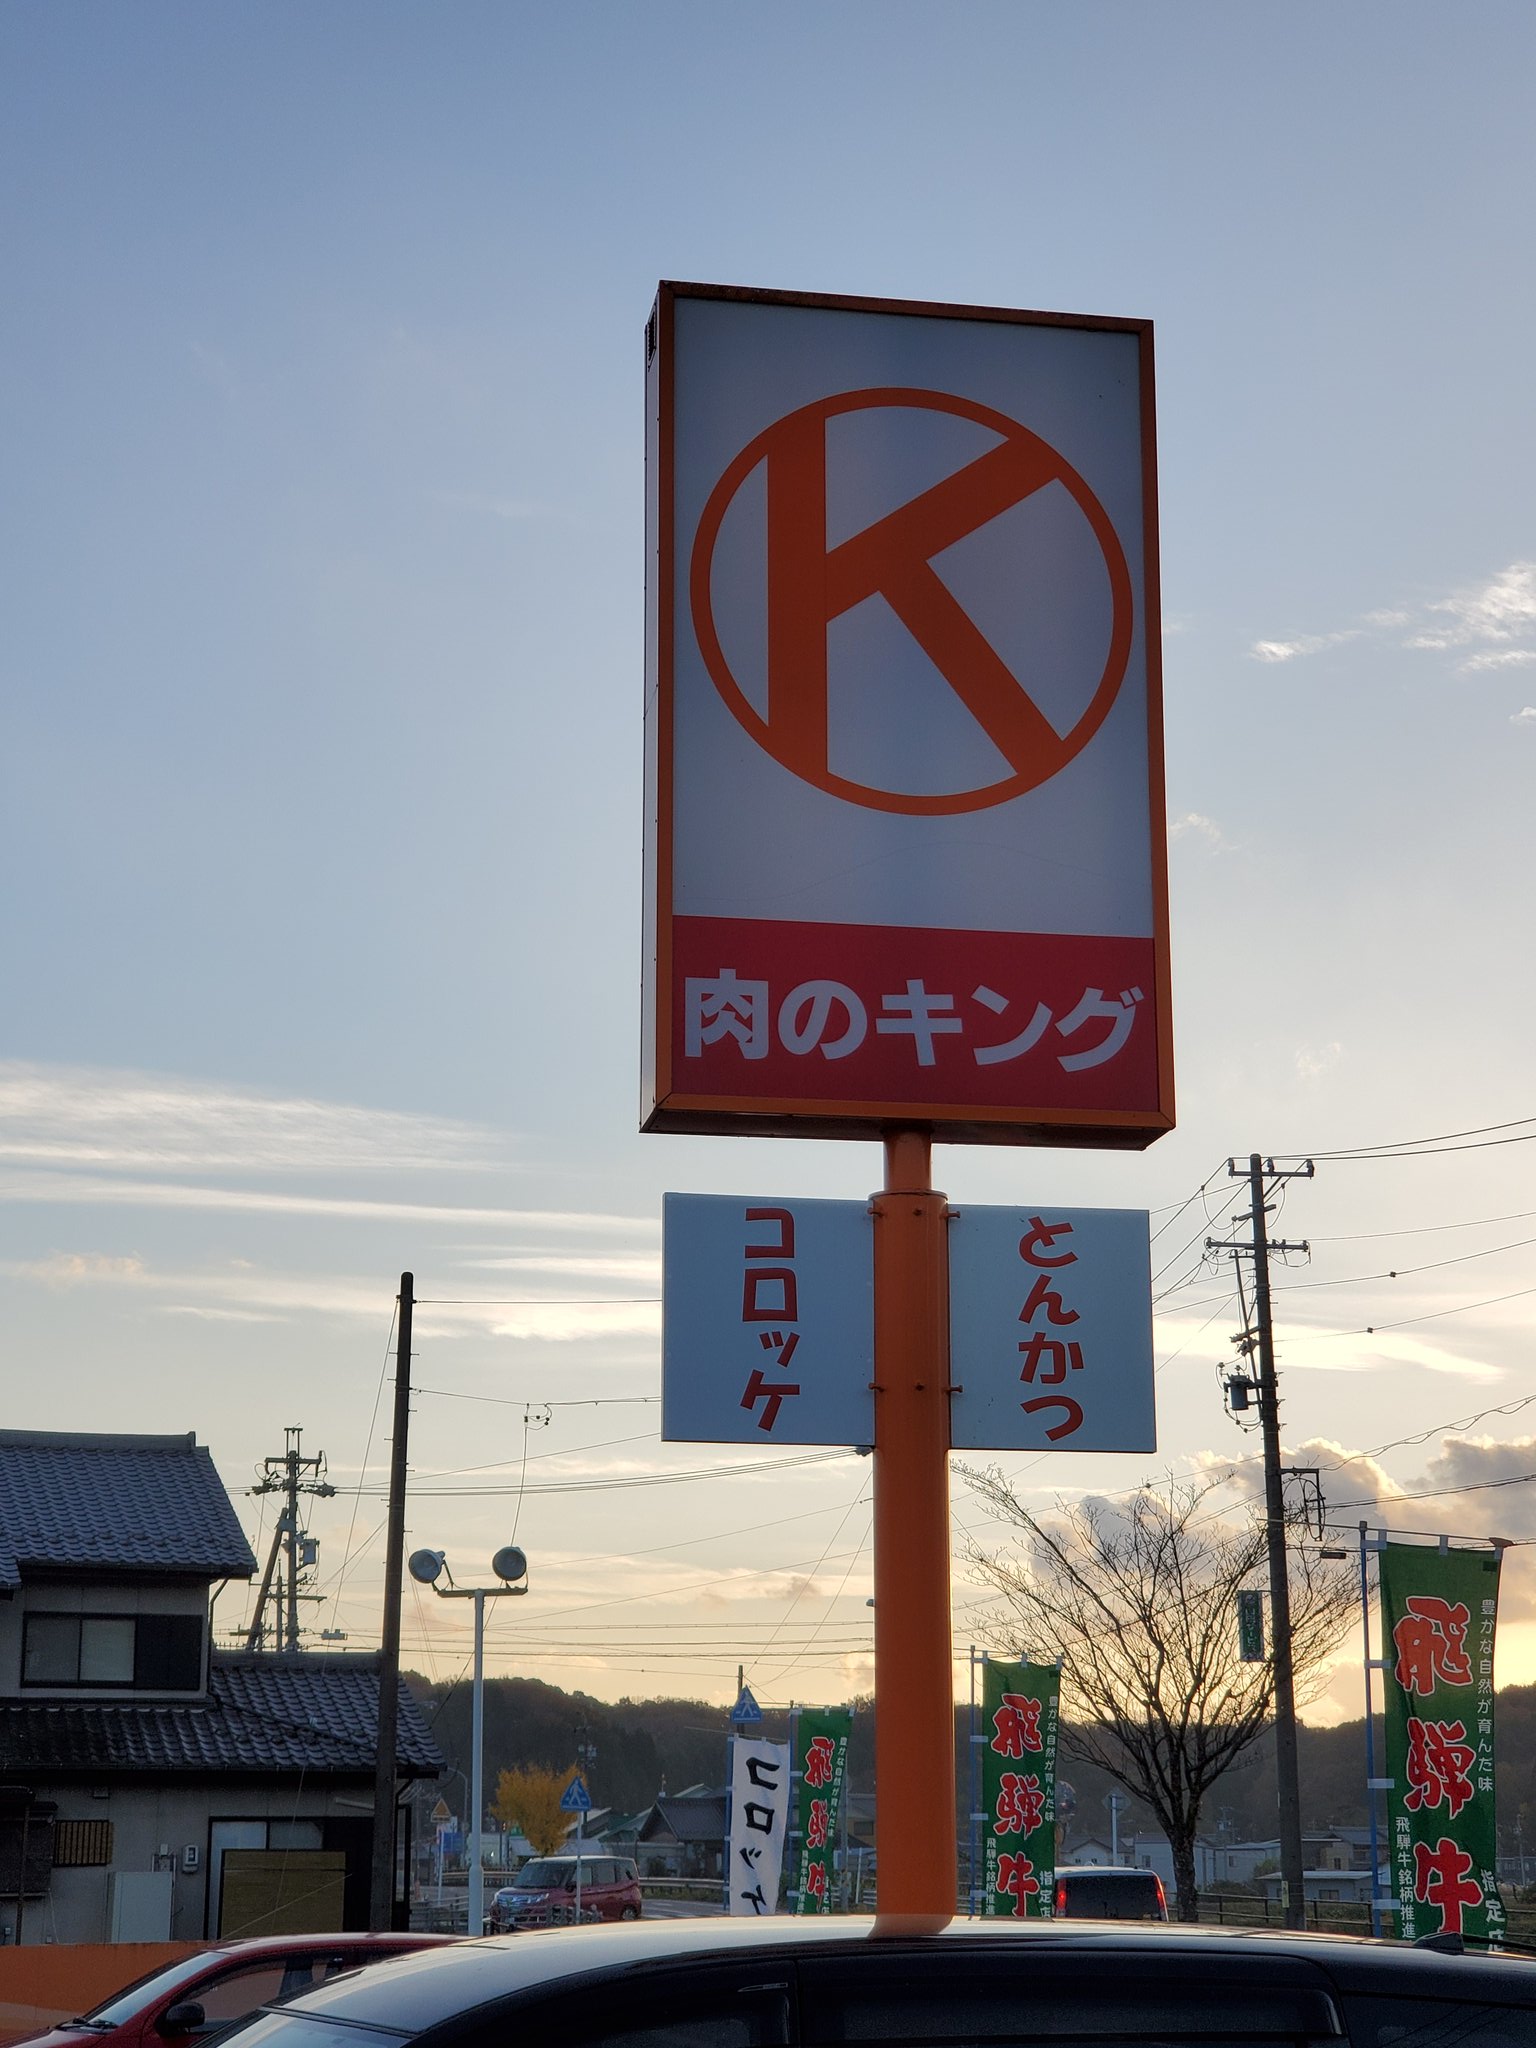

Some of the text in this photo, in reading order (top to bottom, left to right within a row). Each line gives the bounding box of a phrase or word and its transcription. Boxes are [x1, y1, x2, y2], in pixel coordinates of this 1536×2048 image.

[684, 968, 1145, 1073] 肉のキング
[740, 1207, 800, 1434] コロッケ
[1018, 1215, 1085, 1442] とんかつ
[1045, 1697, 1058, 1822] 豊かな自然が育んだ味
[1476, 1598, 1496, 1792] 豊かな自然が育んだ味
